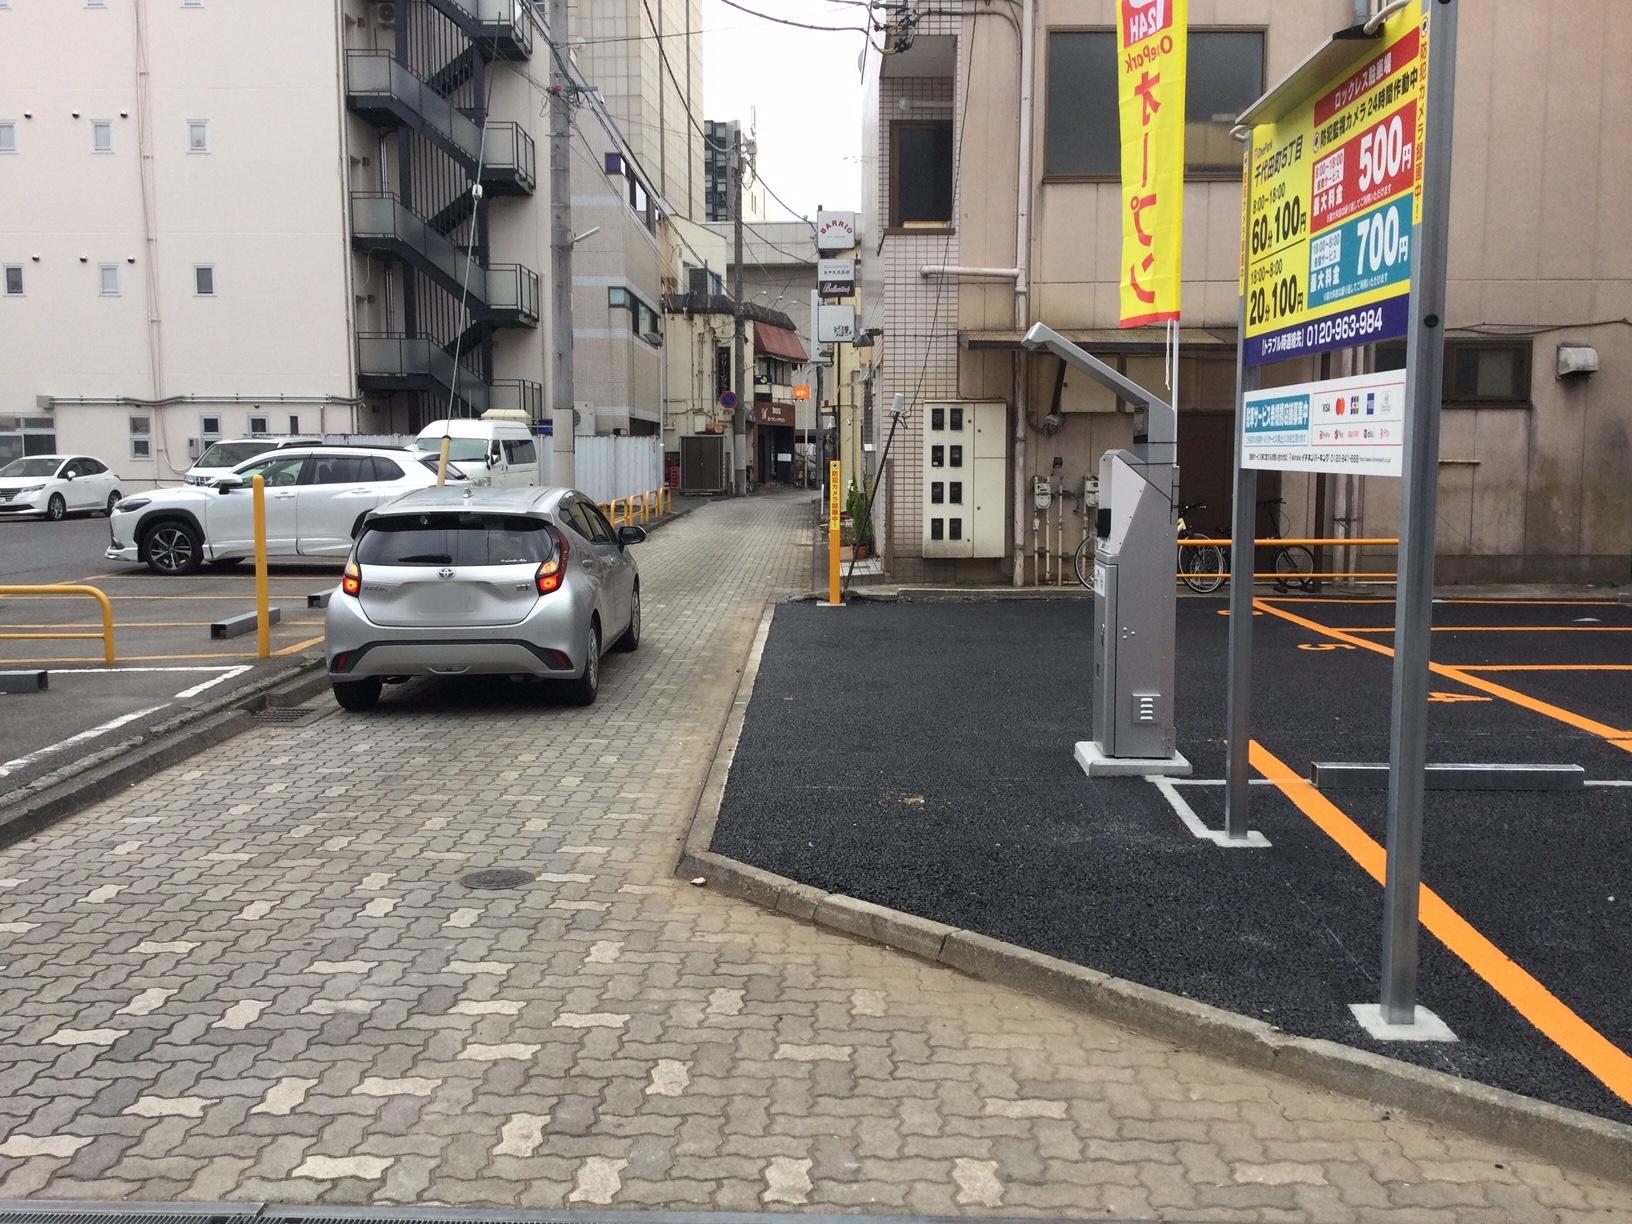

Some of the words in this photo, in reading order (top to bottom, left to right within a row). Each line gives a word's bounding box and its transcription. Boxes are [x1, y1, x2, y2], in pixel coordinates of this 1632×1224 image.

[1334, 52, 1392, 110] ロックレス駐車場
[1255, 134, 1304, 187] 千代田町5丁目
[1359, 115, 1412, 192] 500円
[1313, 183, 1343, 217] 最大料金
[820, 219, 853, 234] BARRIO
[1357, 206, 1408, 275] 700円
[1310, 265, 1340, 293] 最大料金
[1306, 307, 1383, 347] 0120-963-984
